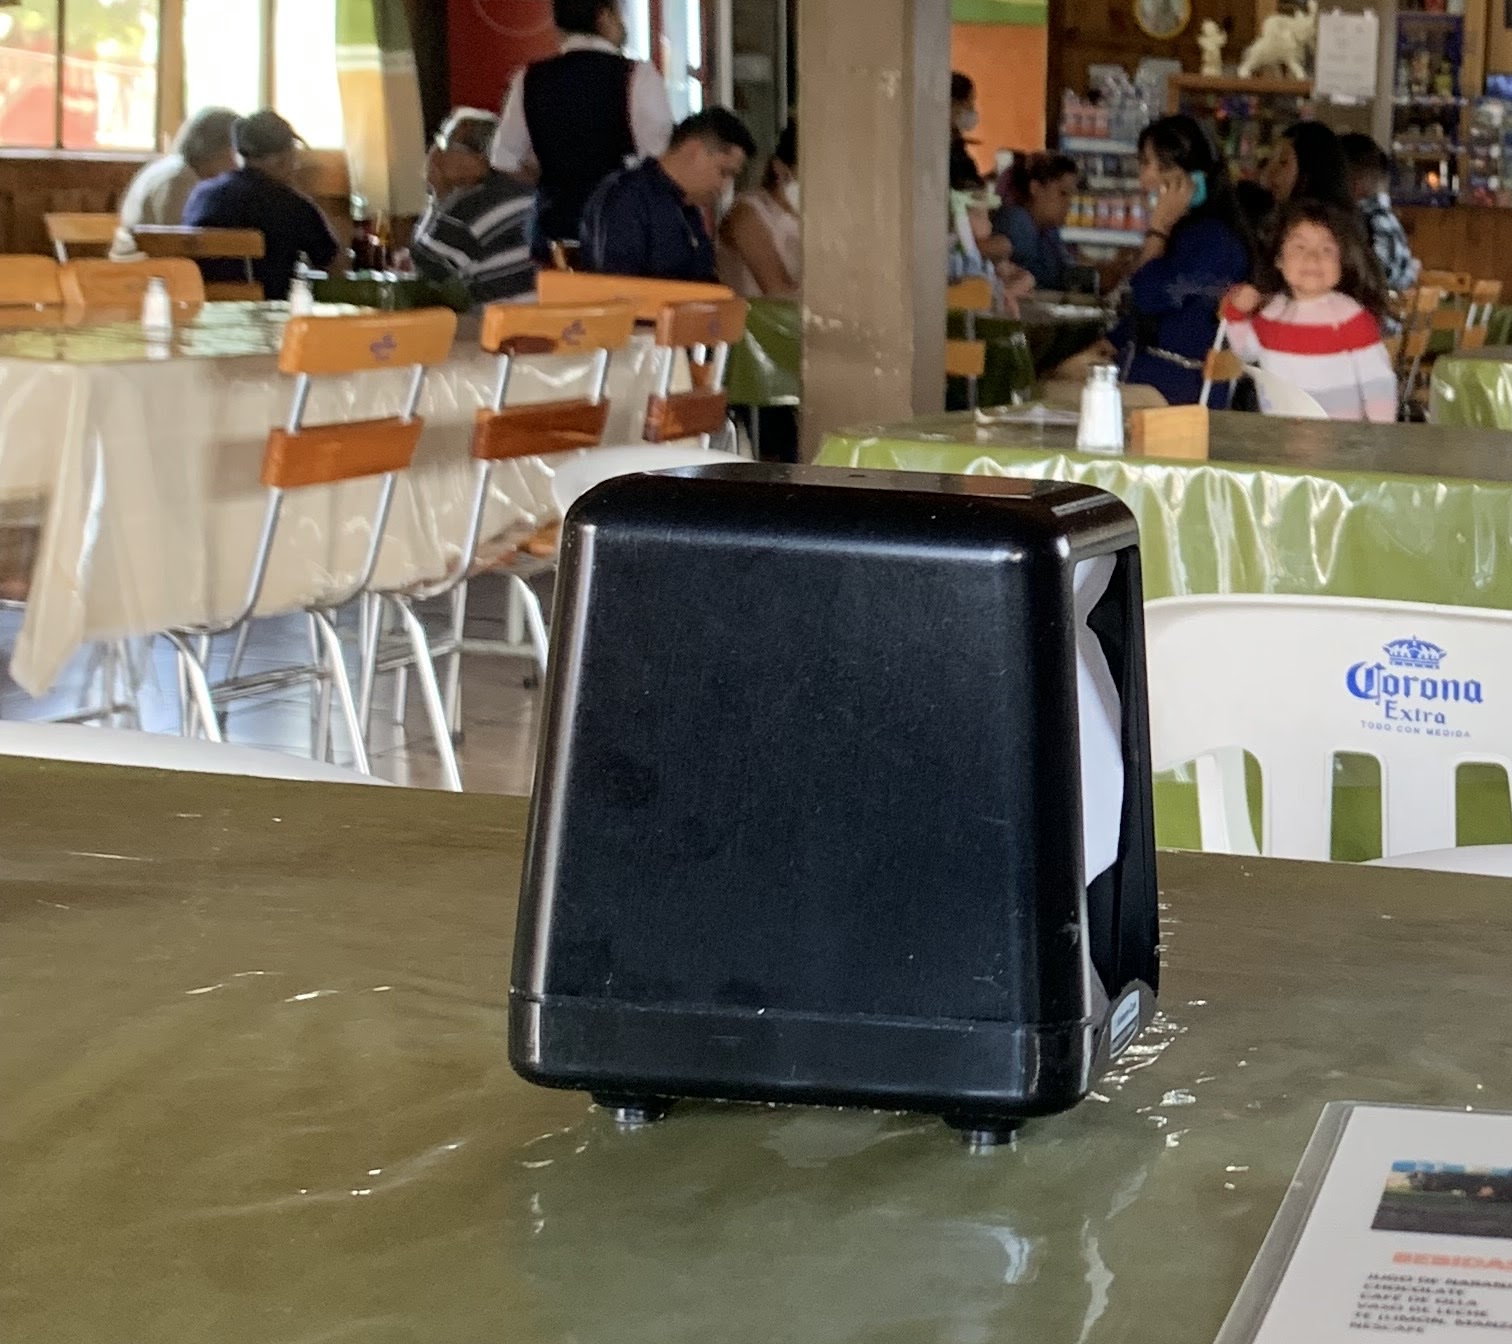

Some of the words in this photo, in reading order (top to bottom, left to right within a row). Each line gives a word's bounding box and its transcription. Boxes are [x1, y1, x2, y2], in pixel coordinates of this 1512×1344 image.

[1346, 661, 1483, 705] Corona
[1384, 699, 1447, 725] Extra
[1360, 719, 1392, 731] TODO
[1396, 725, 1421, 735] CON
[1426, 727, 1472, 739] MEDIDA
